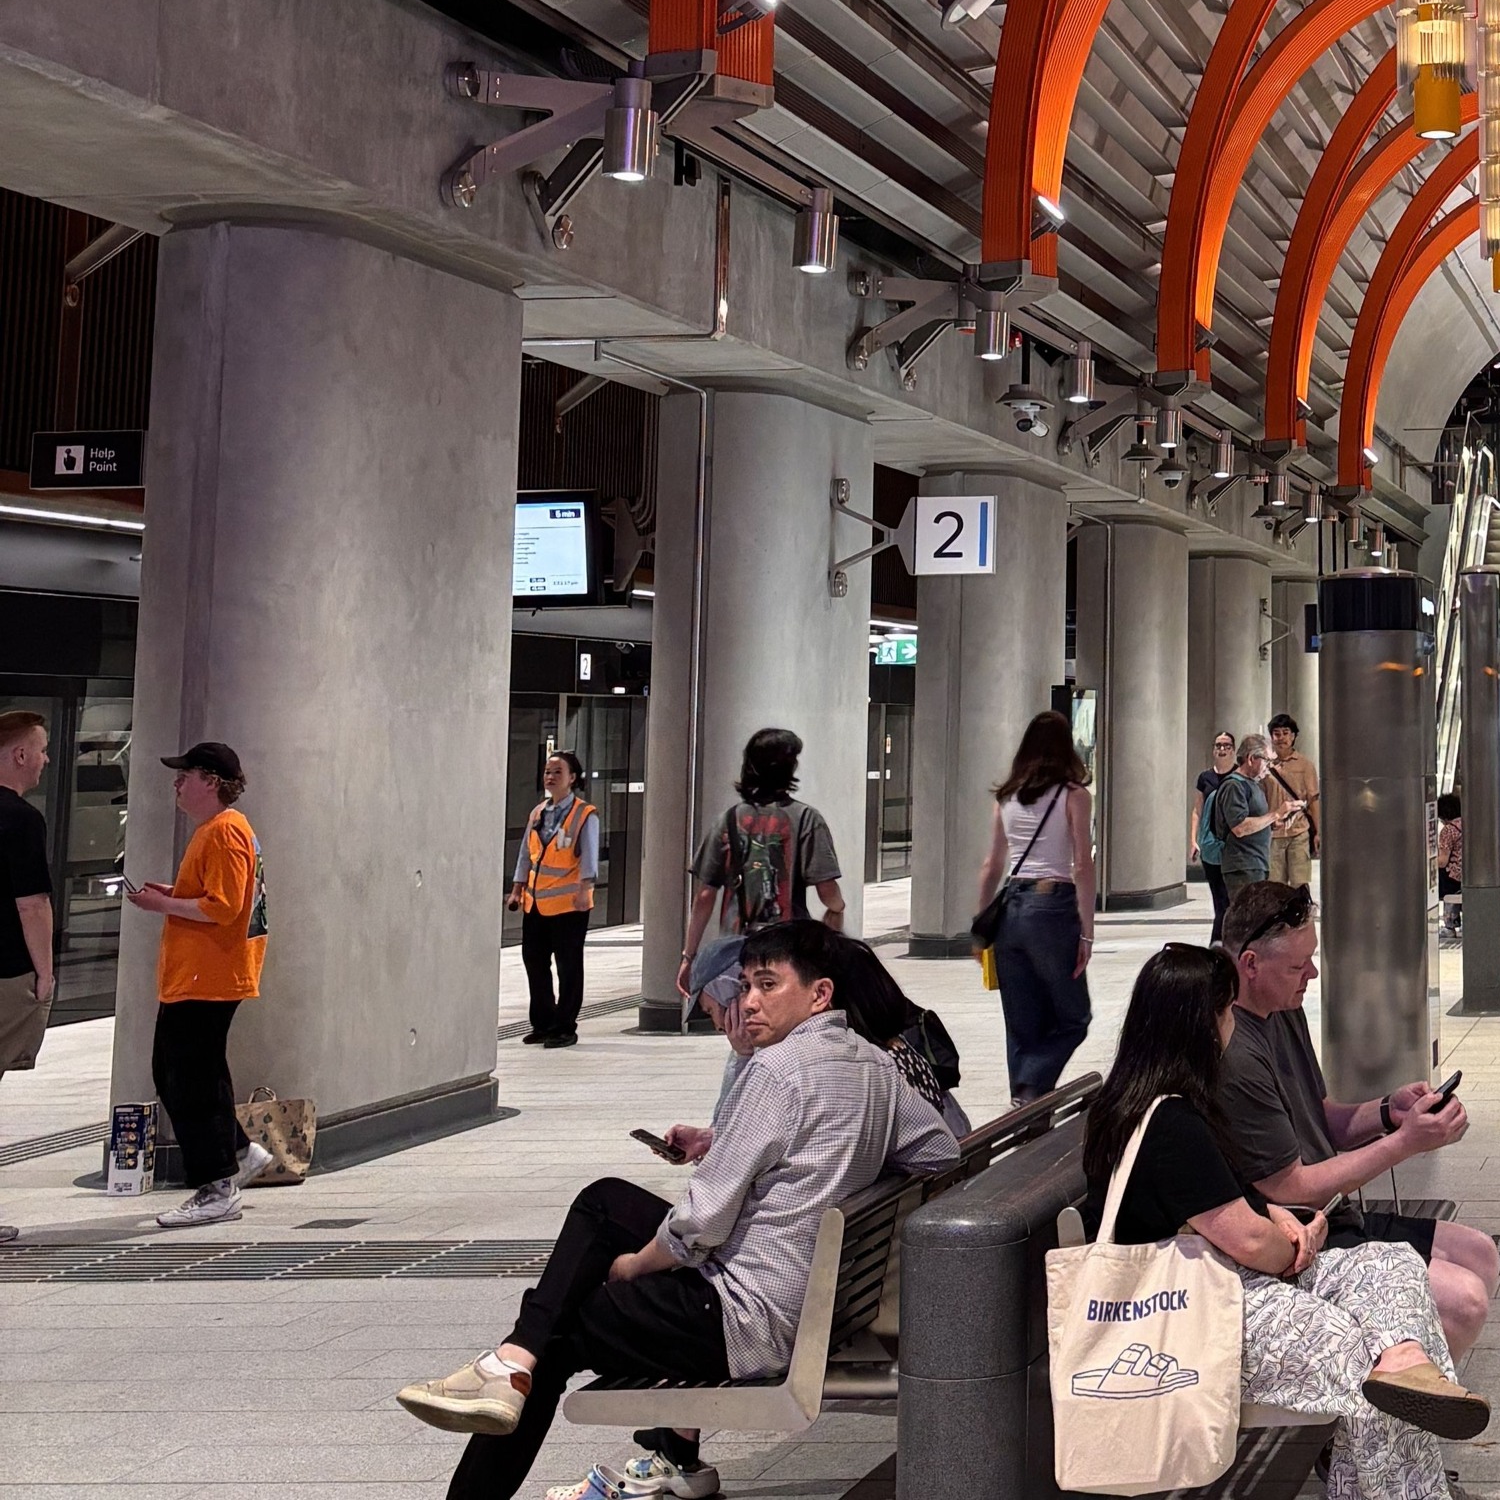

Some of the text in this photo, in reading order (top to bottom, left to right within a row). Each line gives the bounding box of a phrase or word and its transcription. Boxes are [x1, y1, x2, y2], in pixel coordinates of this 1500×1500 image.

[90, 448, 115, 460] Help
[89, 461, 117, 472] Point
[933, 511, 964, 558] 2
[583, 657, 588, 676] 2
[1087, 1289, 1188, 1322] BIRKENSTOCK
